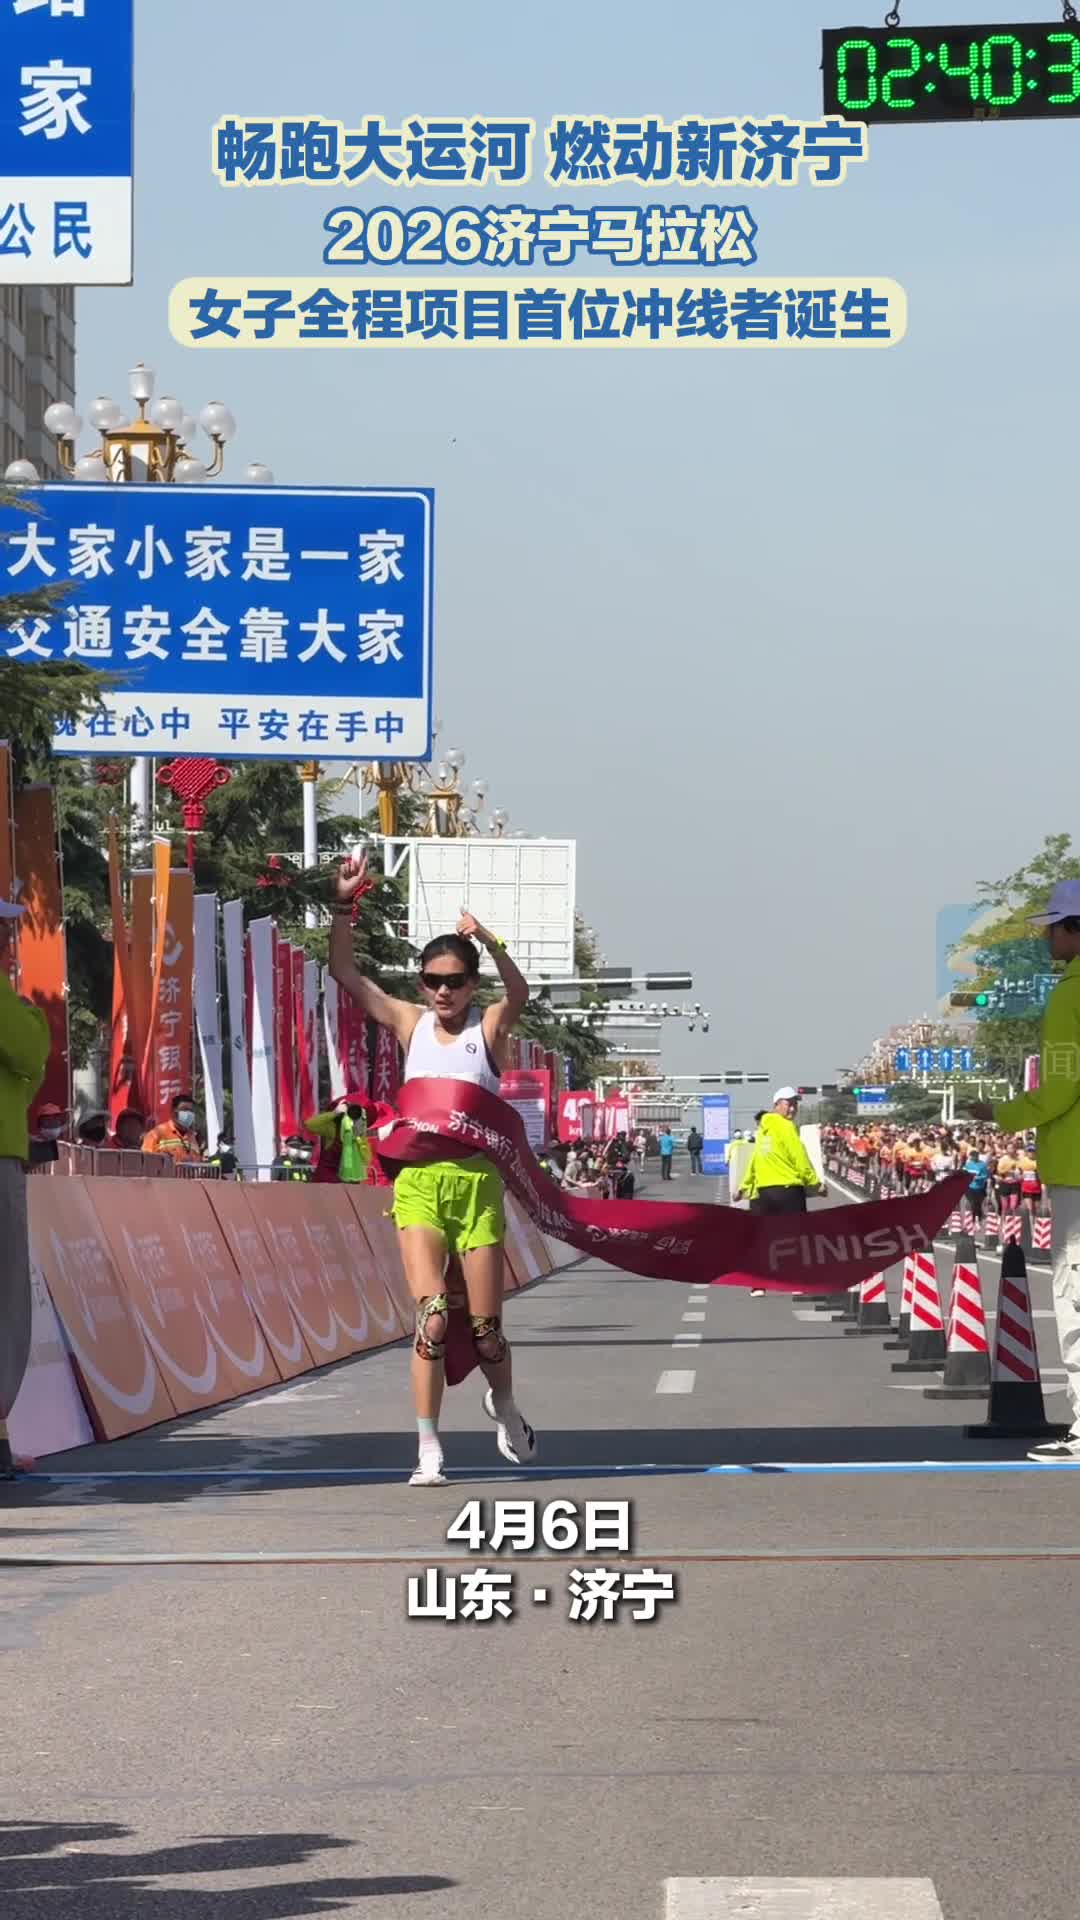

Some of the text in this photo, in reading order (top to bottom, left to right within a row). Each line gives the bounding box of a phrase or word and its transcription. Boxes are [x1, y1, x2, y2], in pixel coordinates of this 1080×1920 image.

[18, 59, 92, 140] 家
[0, 201, 92, 260] 公民
[7, 523, 405, 584] 大家小家是一家
[6, 604, 404, 664] 交通安全靠大家
[219, 707, 403, 743] 平安在手中
[769, 1224, 928, 1271] FINISH
